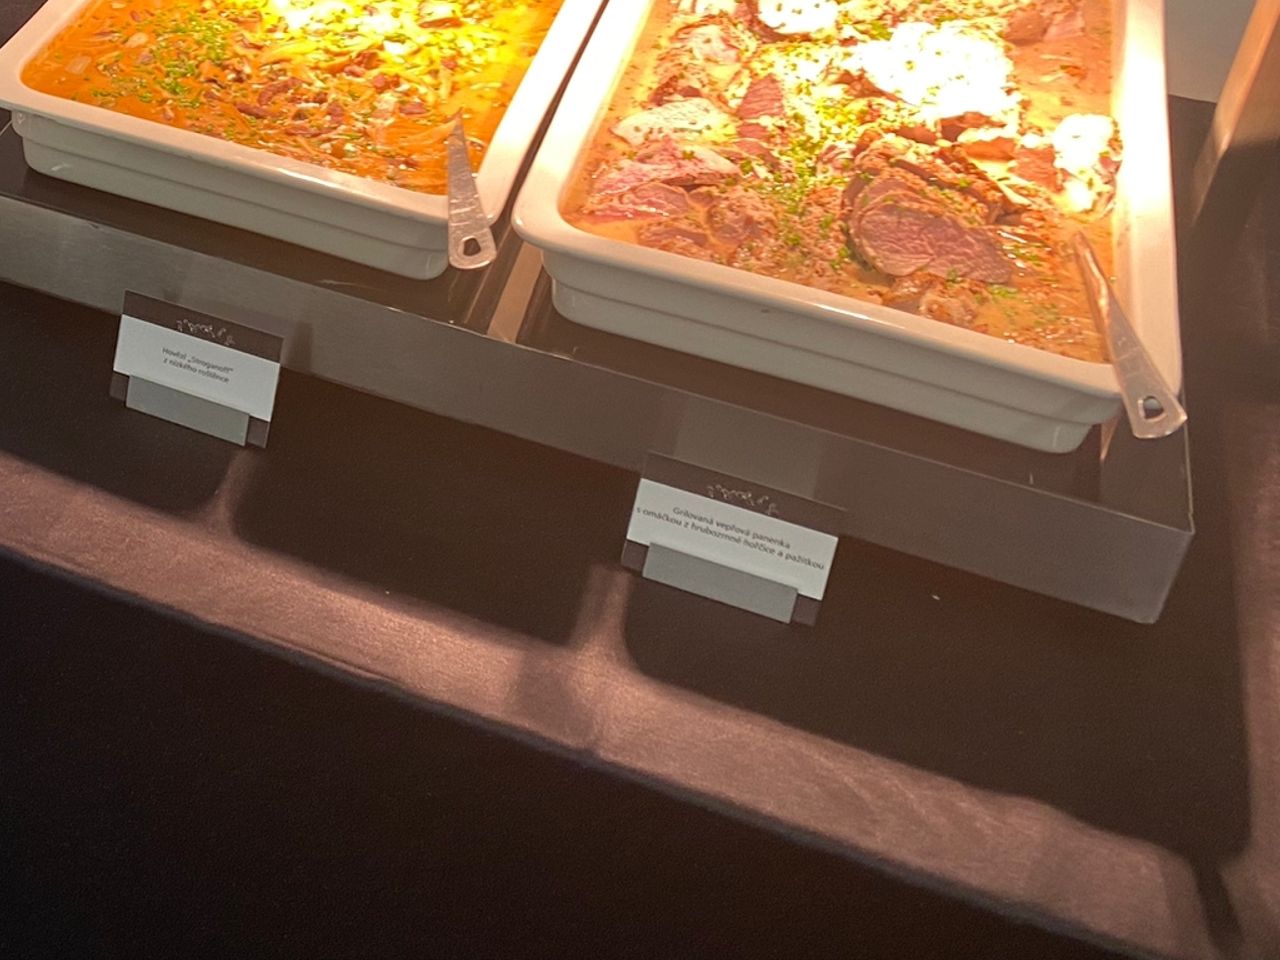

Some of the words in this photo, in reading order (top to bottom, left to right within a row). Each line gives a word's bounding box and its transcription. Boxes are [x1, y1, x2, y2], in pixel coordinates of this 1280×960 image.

[642, 509, 682, 526] omáčkou
[743, 539, 776, 554] hořčice
[785, 553, 824, 570] pažitkou
[672, 507, 714, 525] Grilovaná
[716, 521, 750, 536] vepřová
[752, 532, 790, 549] panenka
